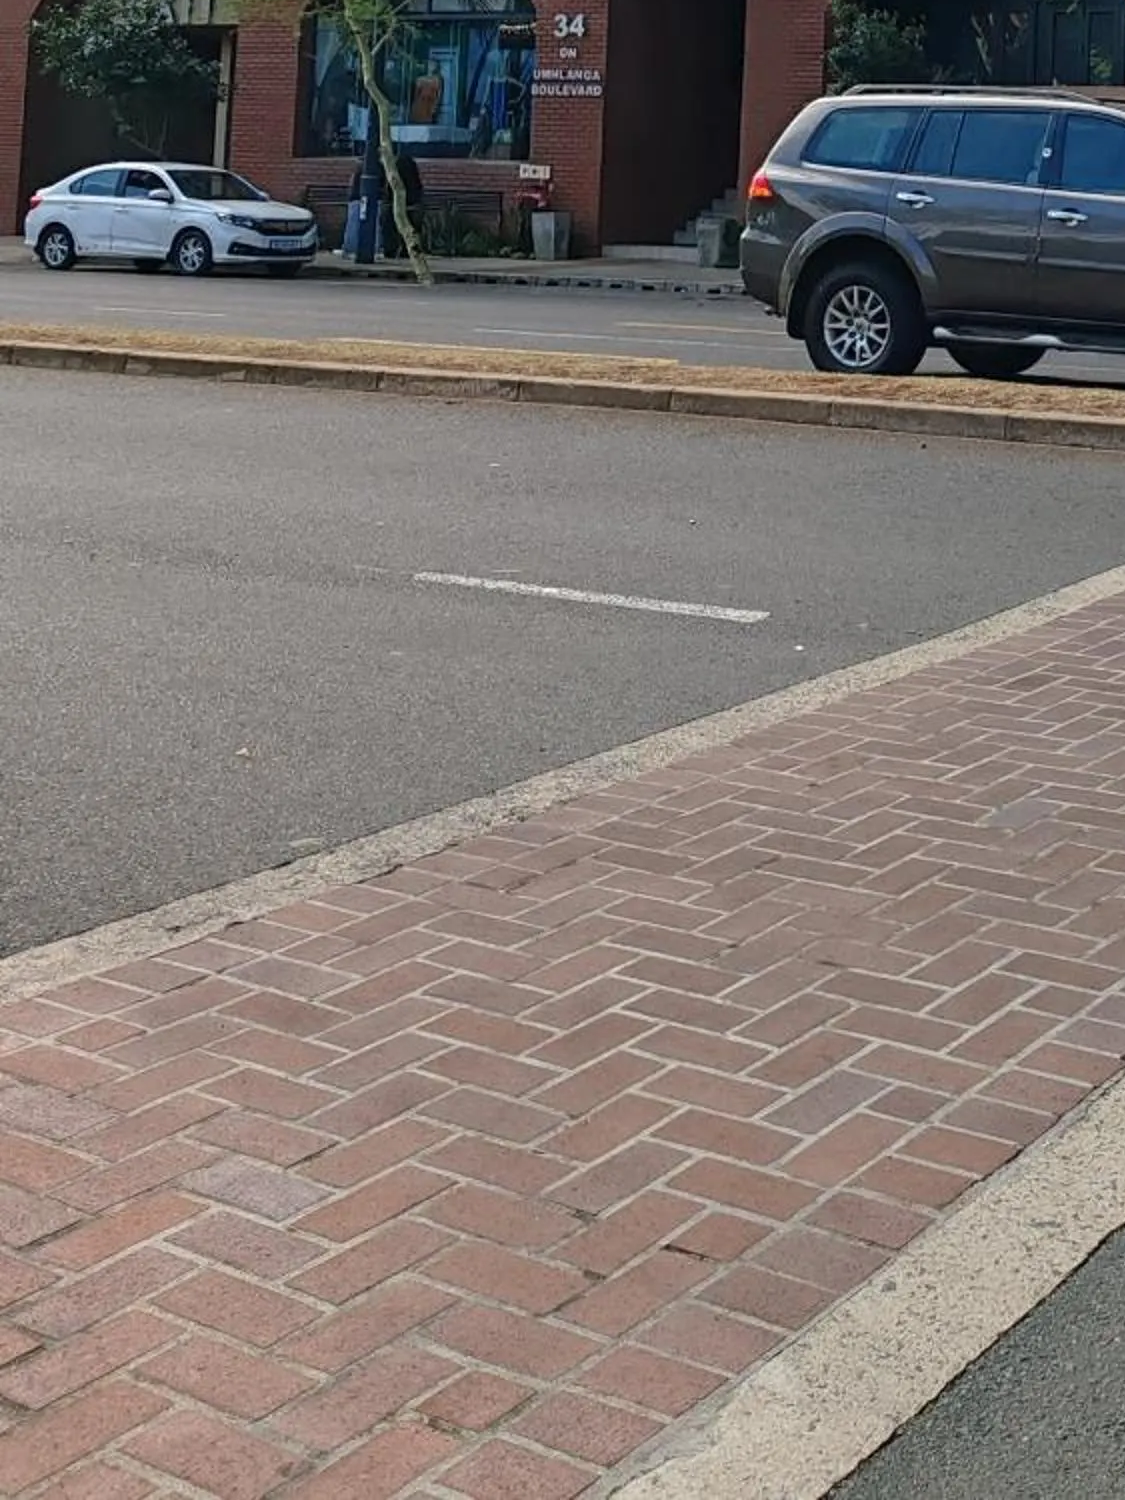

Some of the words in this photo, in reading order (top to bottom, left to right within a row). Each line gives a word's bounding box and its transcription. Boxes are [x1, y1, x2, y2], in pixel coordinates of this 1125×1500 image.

[554, 13, 585, 37] 34
[559, 47, 577, 58] ON
[533, 69, 601, 80] UMHLANGA
[531, 84, 603, 96] BOULEVARD
